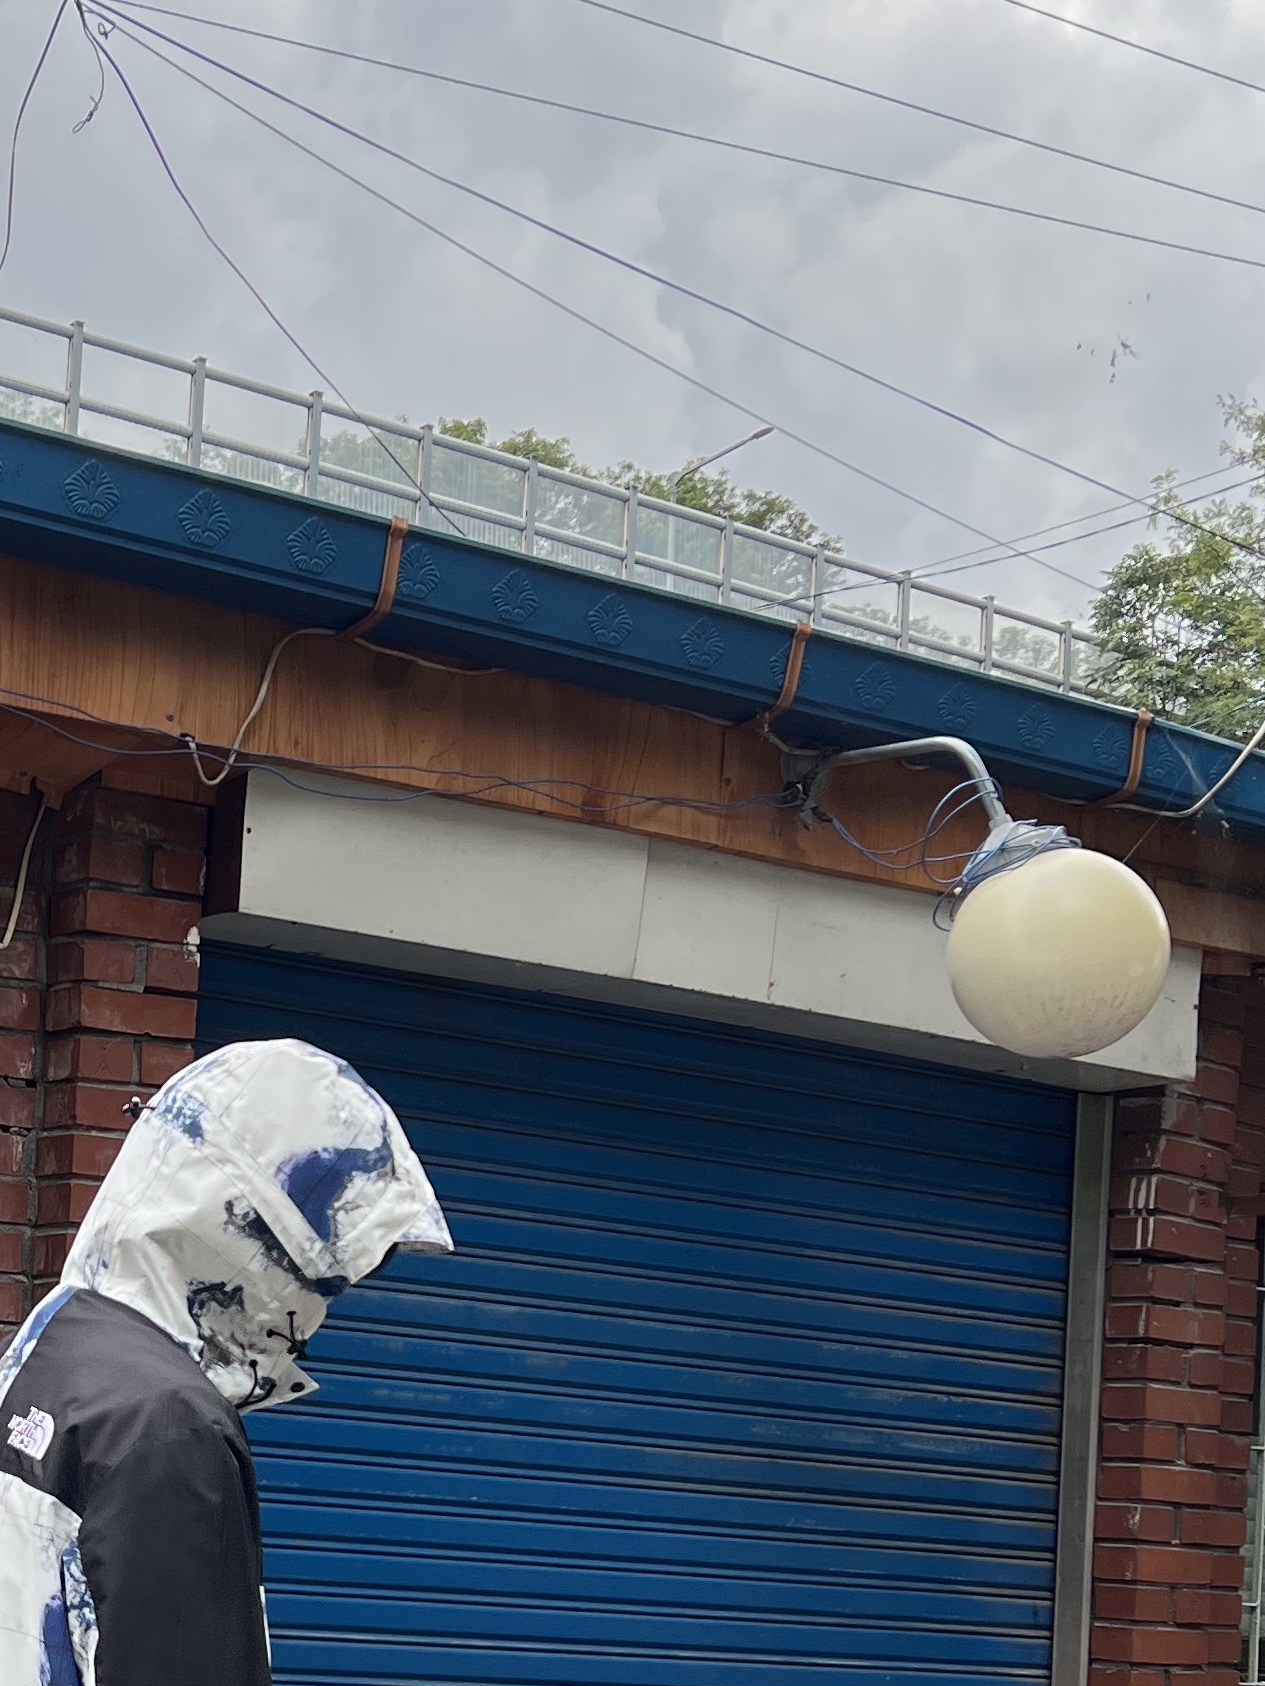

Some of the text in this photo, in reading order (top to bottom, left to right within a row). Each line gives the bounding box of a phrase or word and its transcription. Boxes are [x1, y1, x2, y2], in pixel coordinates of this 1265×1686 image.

[6, 1413, 40, 1438] NORTH
[26, 1405, 47, 1426] THE
[6, 1429, 32, 1451] FACE
